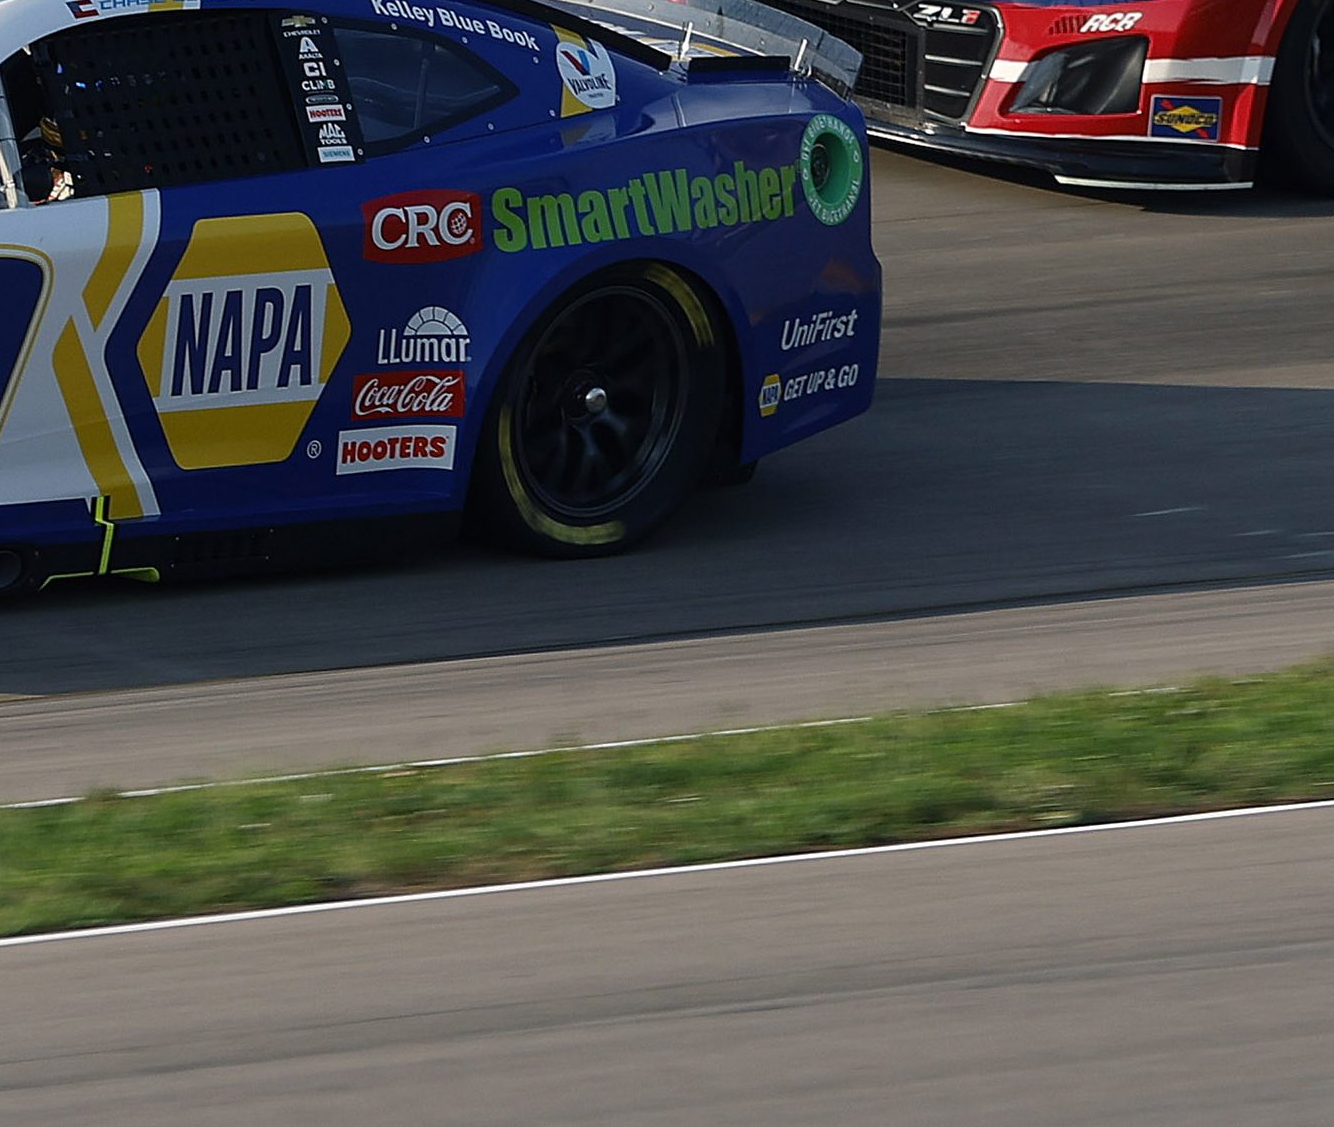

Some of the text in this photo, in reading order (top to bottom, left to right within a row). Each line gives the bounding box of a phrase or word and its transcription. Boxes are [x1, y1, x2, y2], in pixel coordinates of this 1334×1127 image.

[437, 7, 486, 35] Blue
[486, 20, 541, 51] Book
[1080, 12, 1144, 33] RCR
[567, 75, 612, 96] VALVOLINE
[319, 122, 346, 139] MAC
[1154, 111, 1218, 126] SUNOCO
[492, 161, 796, 253] SmartWasher
[371, 202, 473, 250] CRC
[171, 284, 313, 396] NAPA
[378, 329, 470, 364] LLumar
[781, 309, 858, 350] UniFirst
[784, 375, 807, 401] GET
[807, 371, 825, 394] UP
[825, 369, 836, 390] &
[838, 364, 858, 388] GO
[341, 435, 446, 464] HOOTERS
